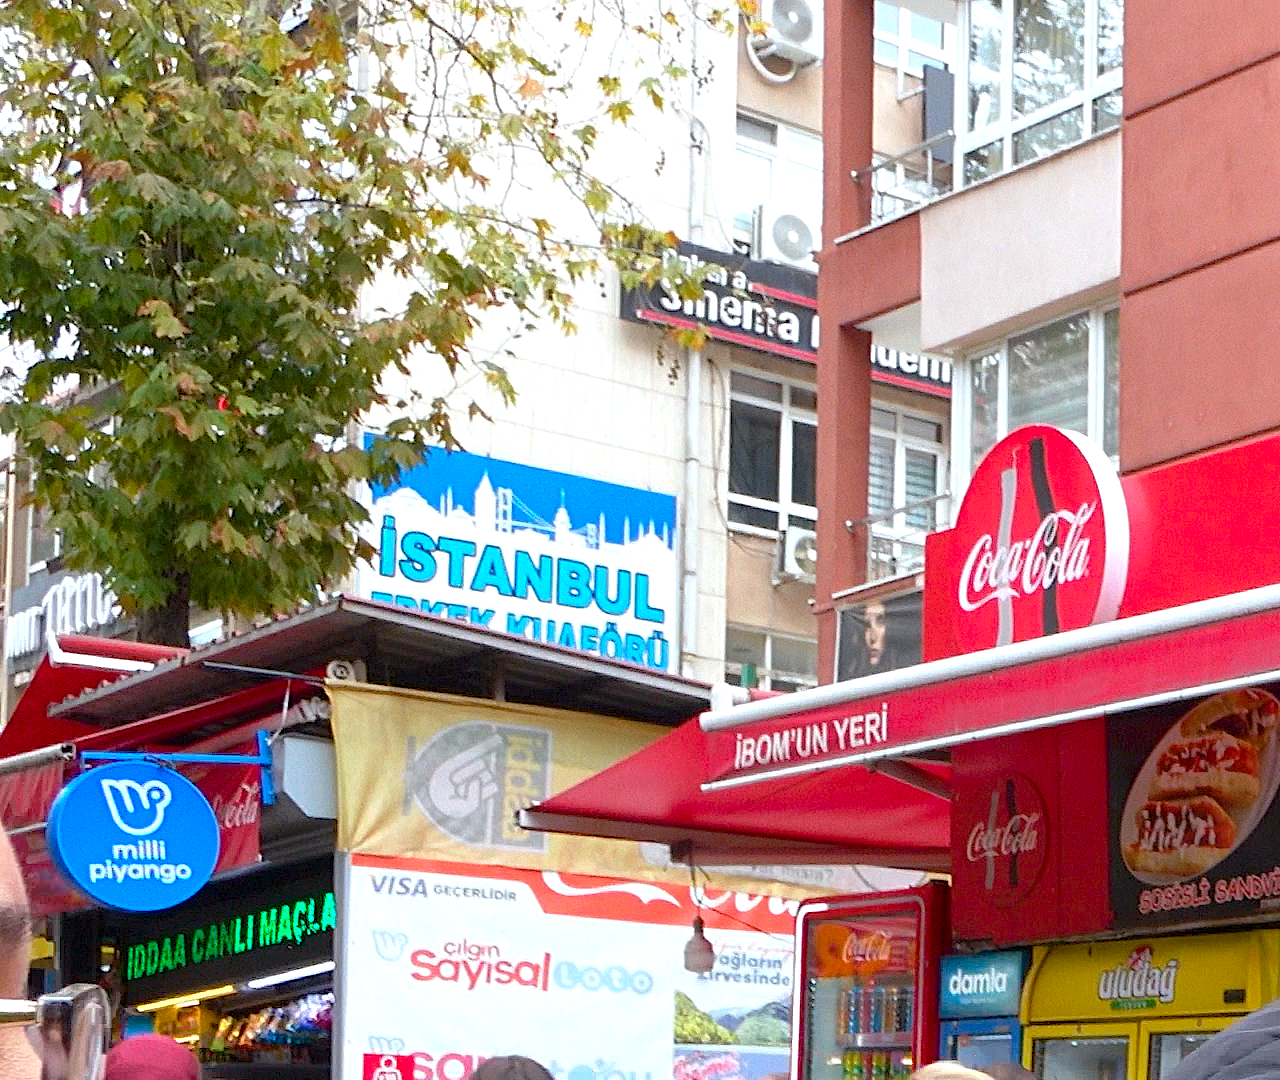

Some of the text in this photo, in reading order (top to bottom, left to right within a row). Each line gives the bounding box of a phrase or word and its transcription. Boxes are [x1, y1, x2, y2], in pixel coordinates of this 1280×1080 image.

[379, 515, 665, 623] İSTANBUL
[958, 499, 1097, 611] Coca-Cola
[734, 702, 889, 770] İBOM'UN YERİ
[112, 840, 166, 860] milli
[89, 860, 192, 884] piyango
[369, 873, 430, 899] VISA
[410, 949, 552, 992] Sayısal
[949, 966, 1008, 995] damla
